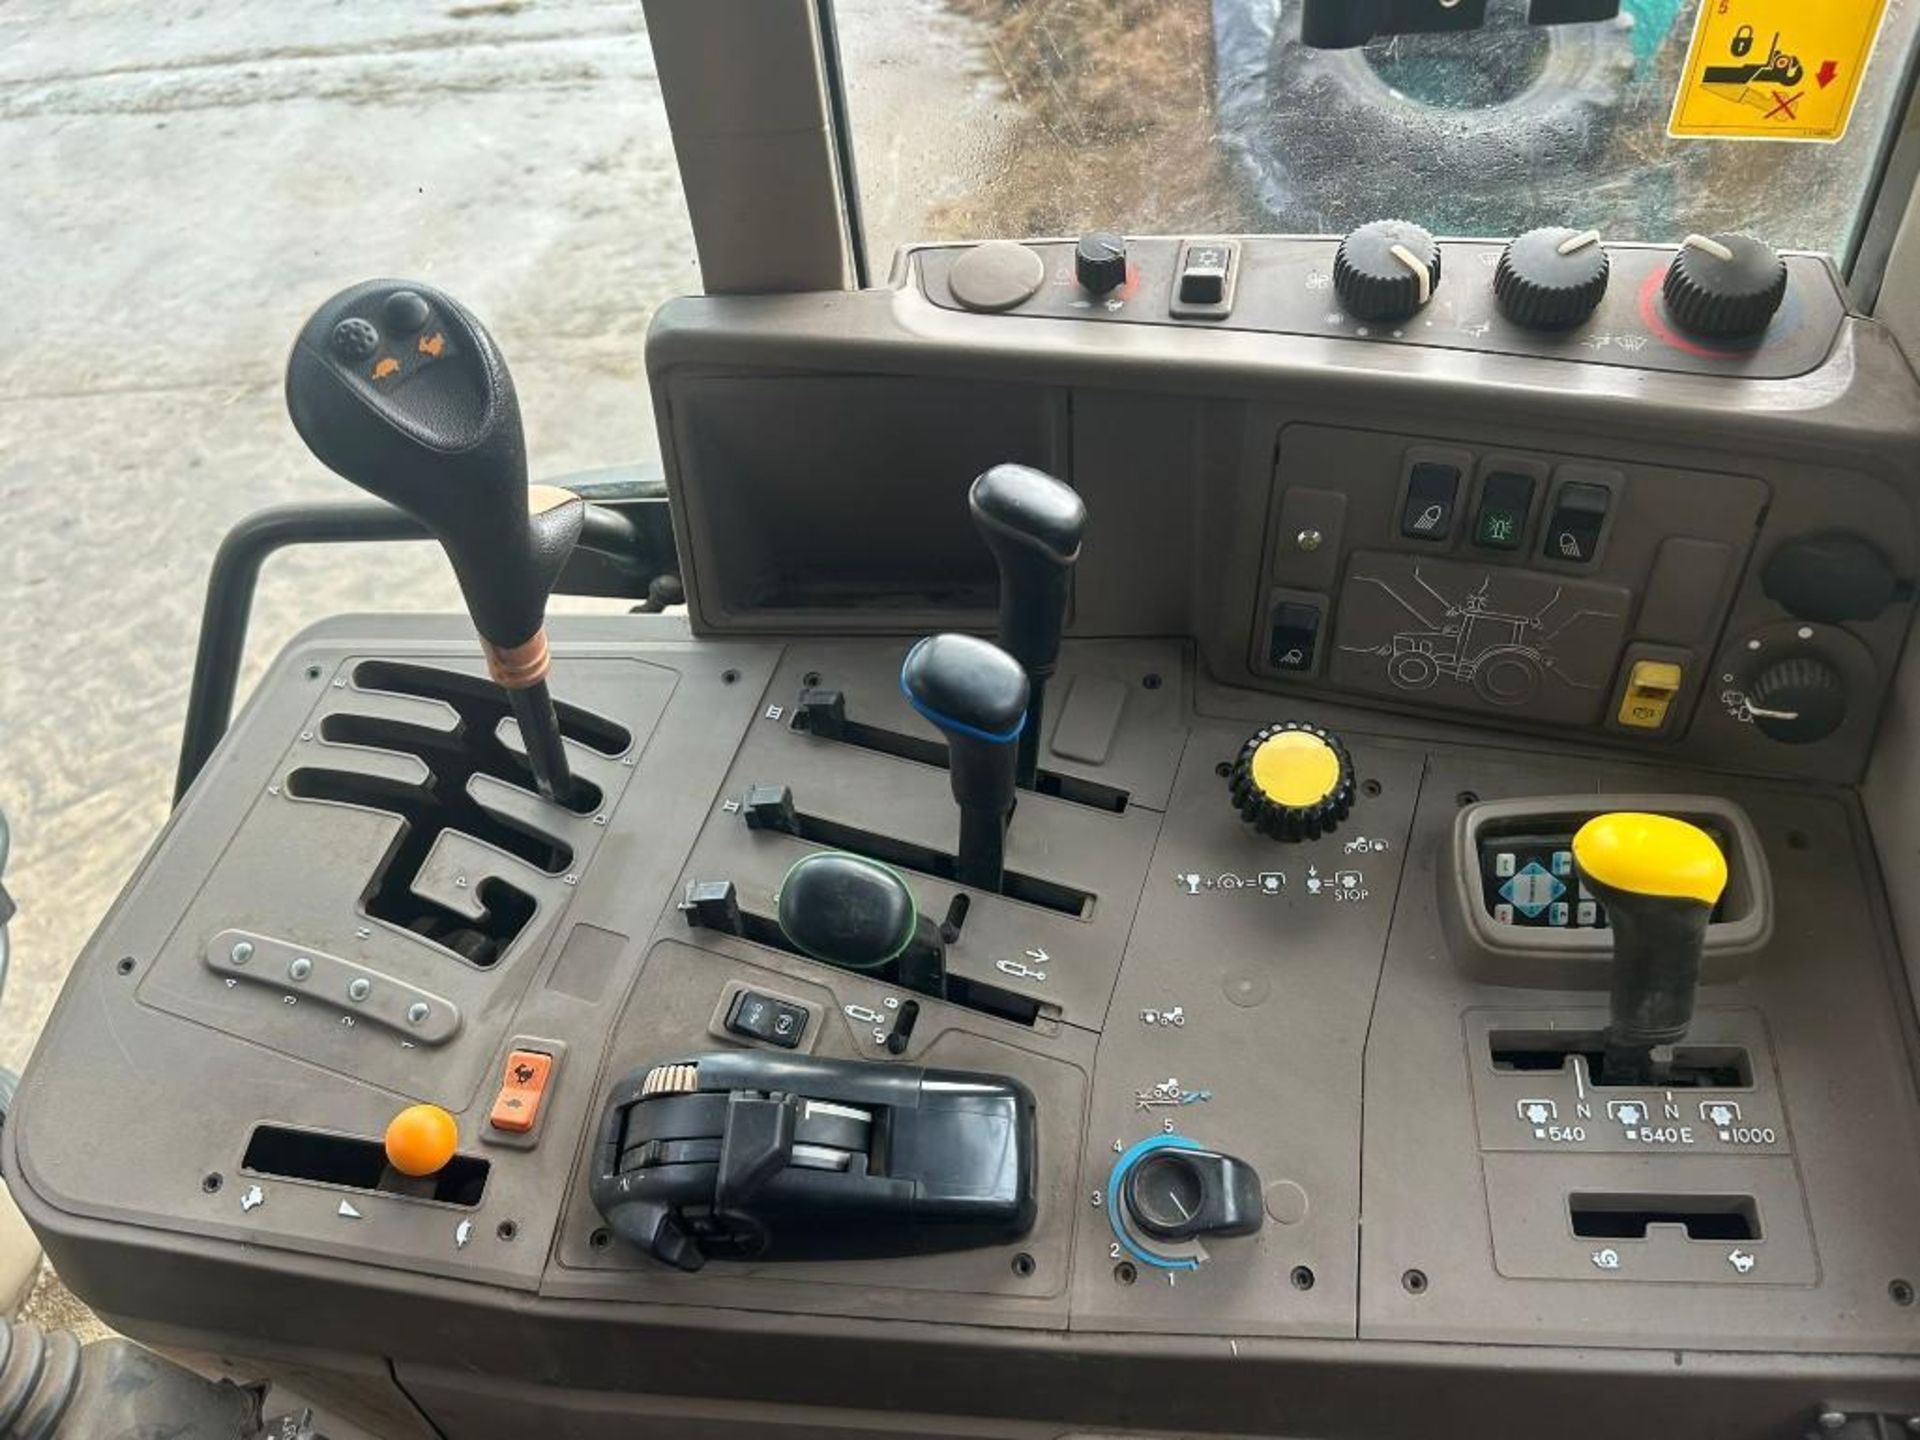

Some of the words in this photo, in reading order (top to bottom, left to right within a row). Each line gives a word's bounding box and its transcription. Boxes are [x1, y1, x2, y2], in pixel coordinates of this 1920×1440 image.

[1335, 889, 1369, 901] STOP
[342, 1016, 355, 1027] 2
[1576, 1104, 1592, 1119] N
[1664, 1104, 1680, 1119] N
[1163, 1119, 1174, 1132] 5
[1549, 1127, 1586, 1142] 540
[1732, 1128, 1775, 1143] 1000
[1112, 1138, 1124, 1152] 4
[1092, 1190, 1102, 1205] 3
[1110, 1243, 1121, 1257] 2
[1168, 1272, 1176, 1285] 1
